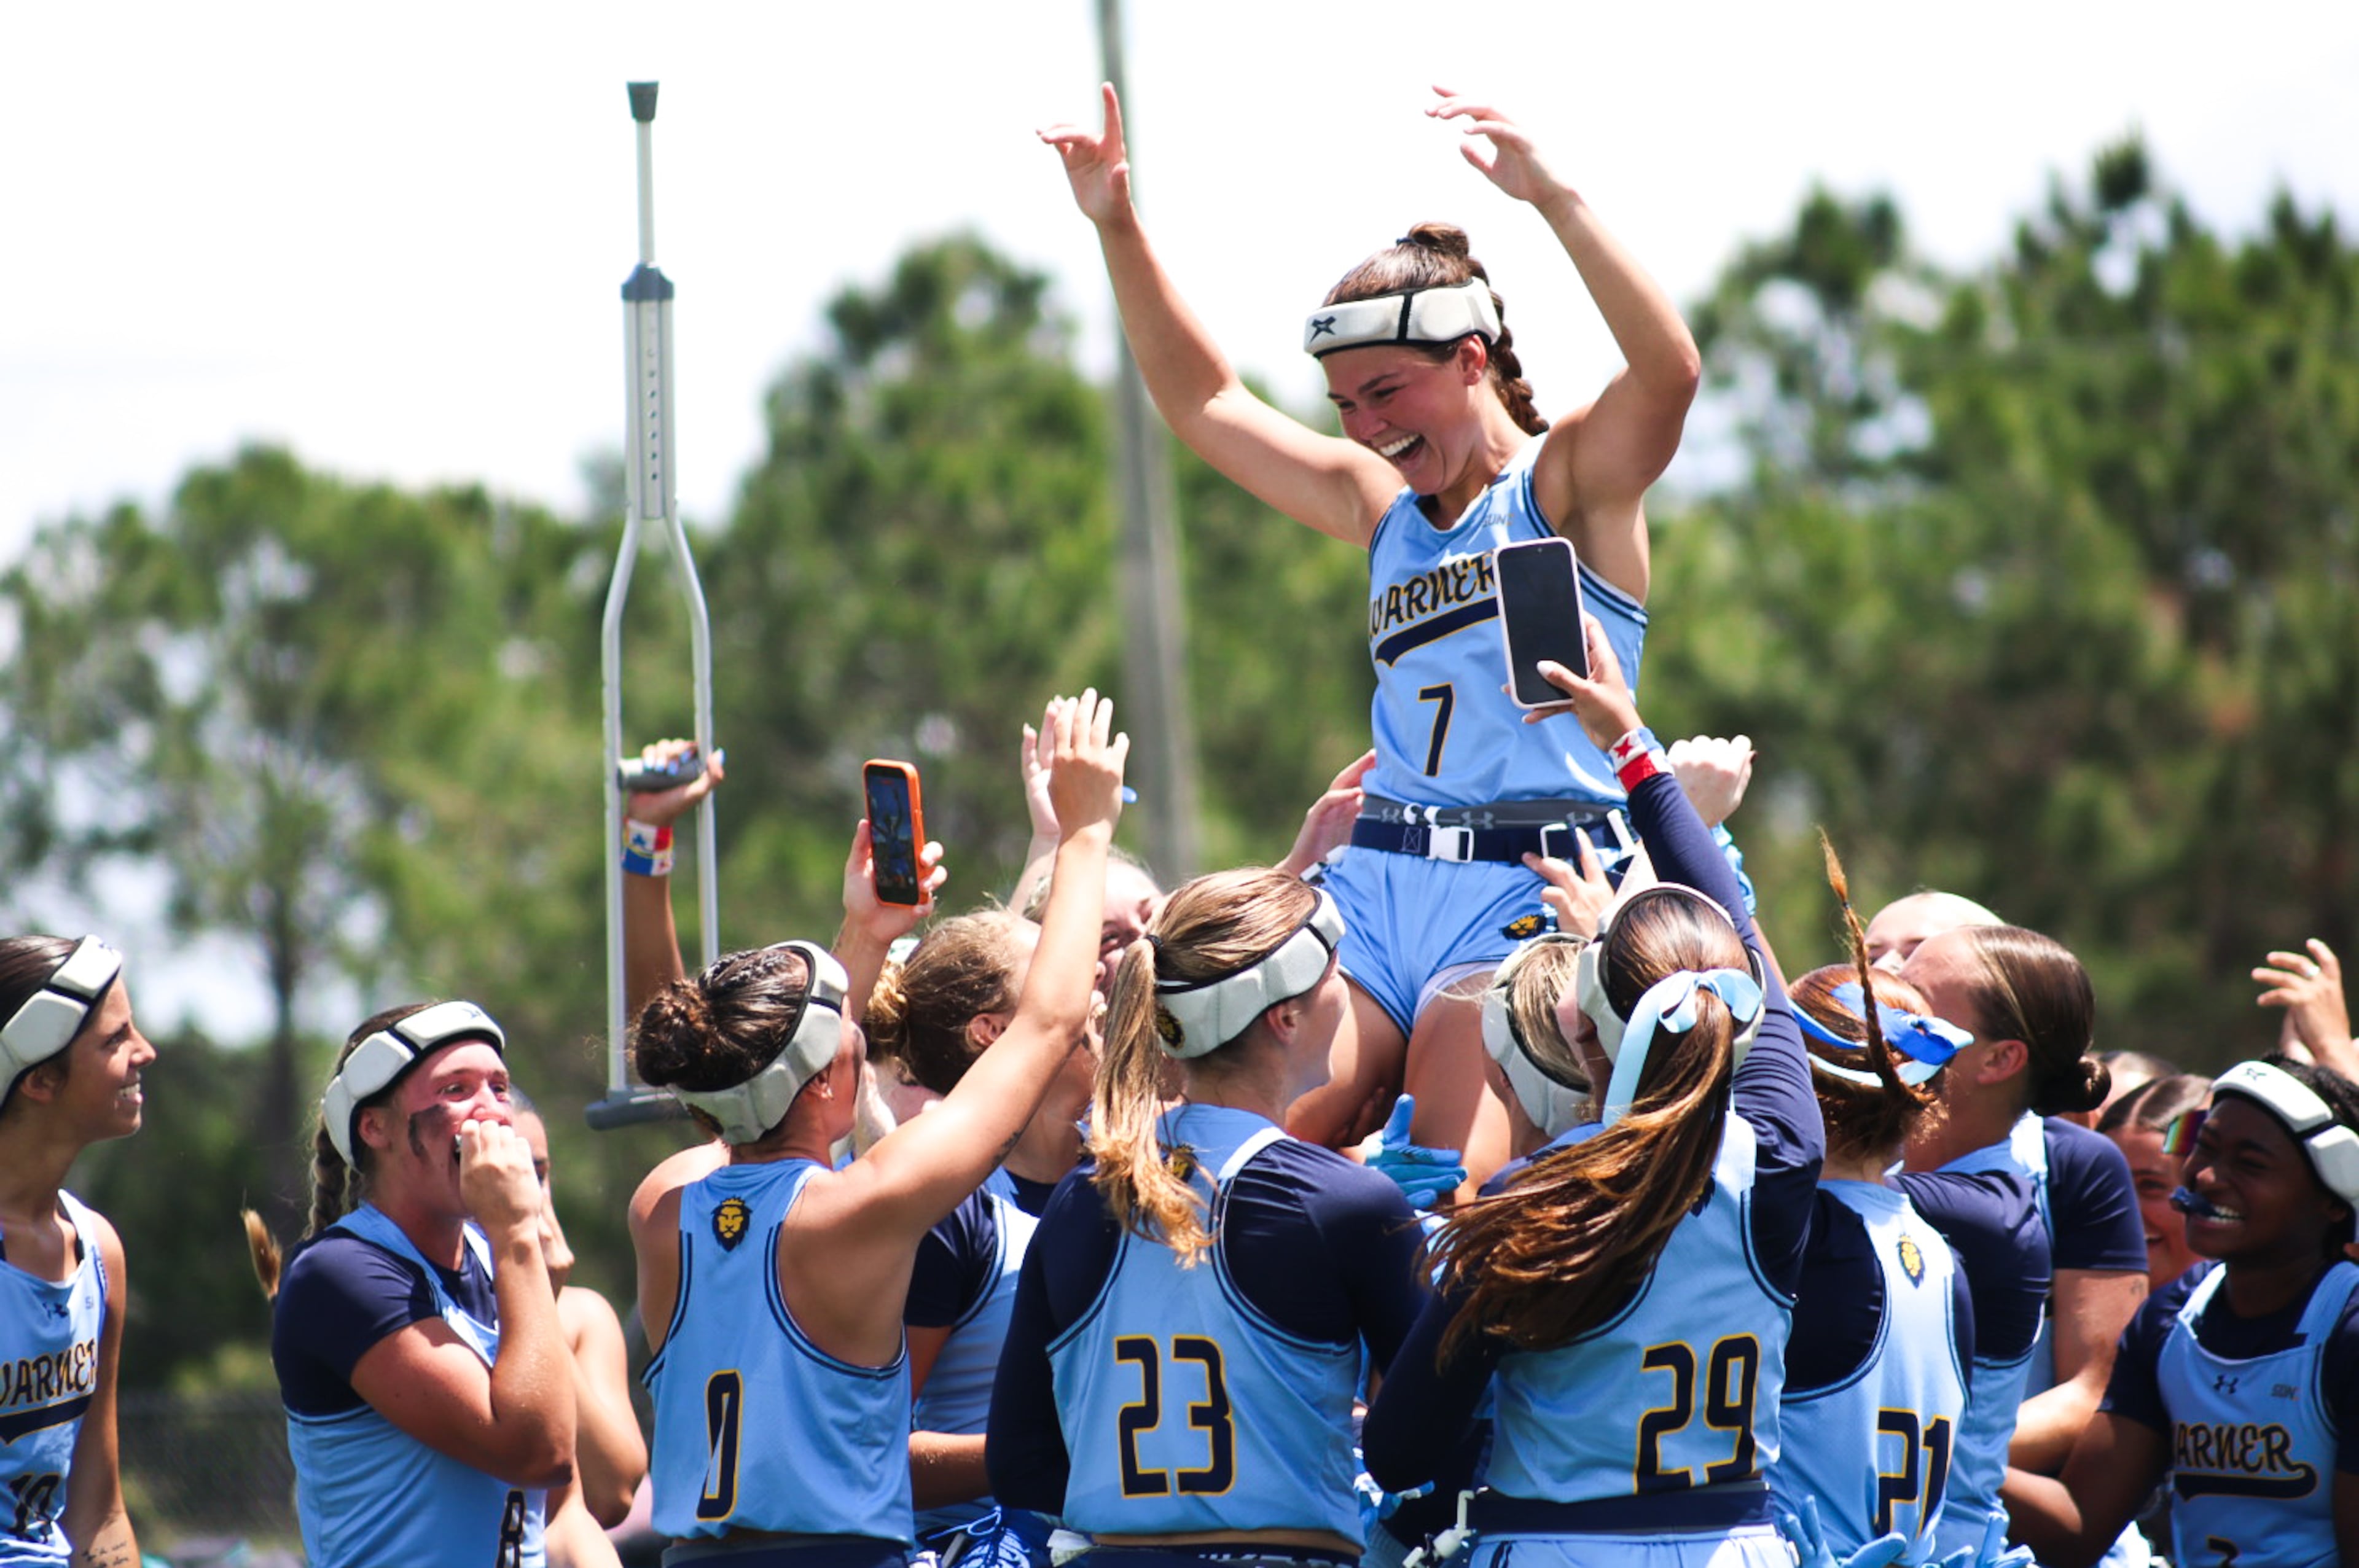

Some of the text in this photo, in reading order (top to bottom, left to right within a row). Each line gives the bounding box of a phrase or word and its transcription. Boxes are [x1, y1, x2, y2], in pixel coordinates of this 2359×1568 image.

[1417, 682, 1454, 778] 7
[695, 1369, 743, 1522] 0
[1114, 1333, 1236, 1499] 23
[1633, 1332, 1761, 1494] 29
[2173, 1422, 2306, 1474] ARNER
